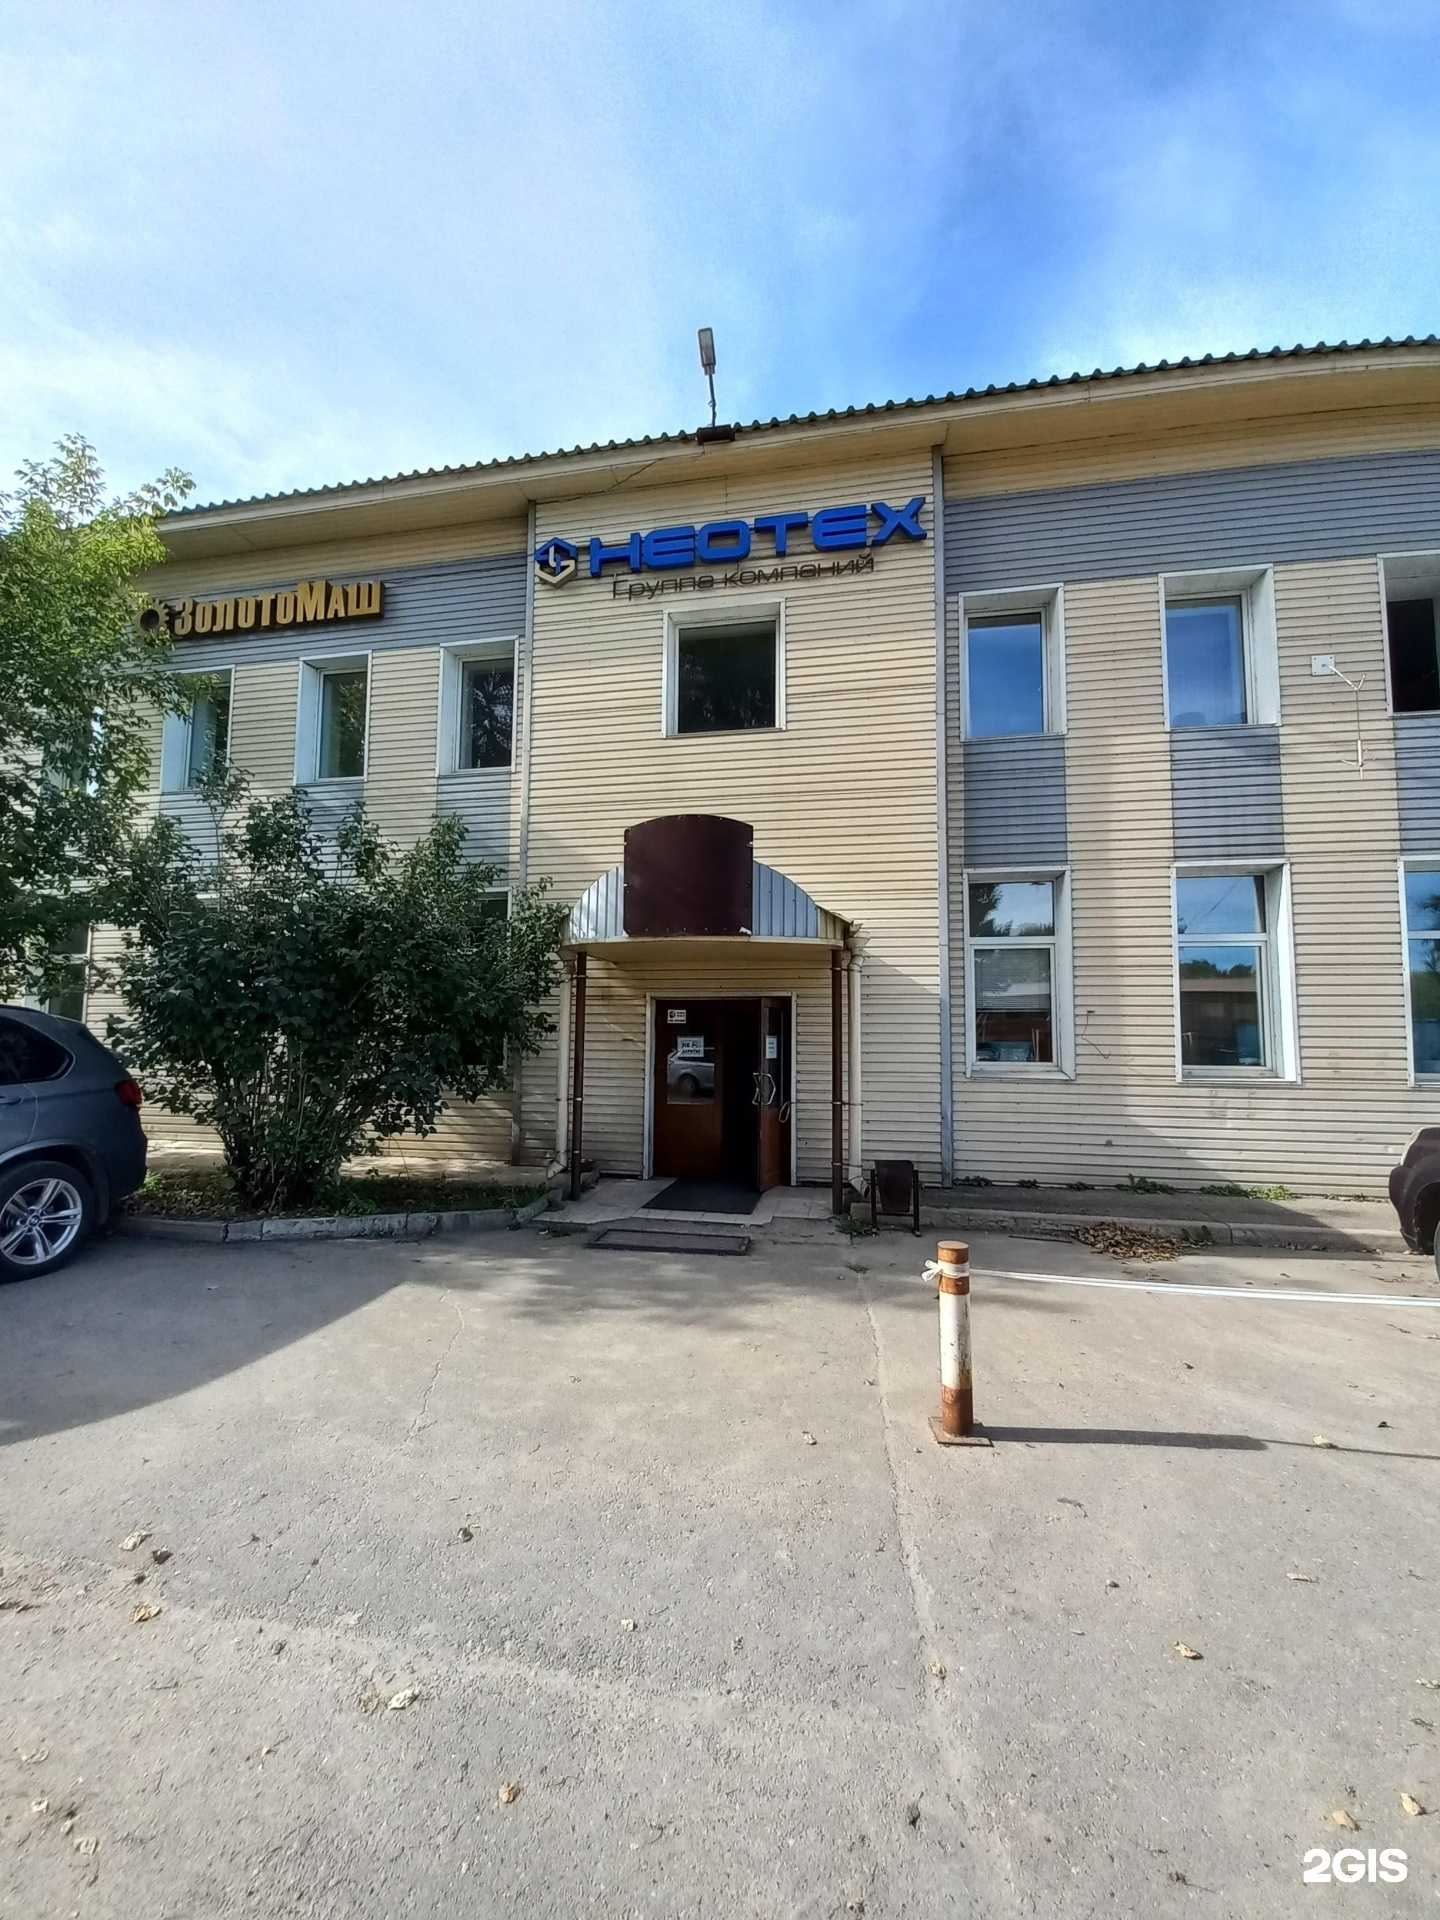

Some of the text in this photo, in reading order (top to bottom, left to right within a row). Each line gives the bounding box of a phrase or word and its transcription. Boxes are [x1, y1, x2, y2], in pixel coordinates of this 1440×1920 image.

[589, 496, 928, 577] НЕОТЕХ
[612, 551, 875, 601] Группа компаний
